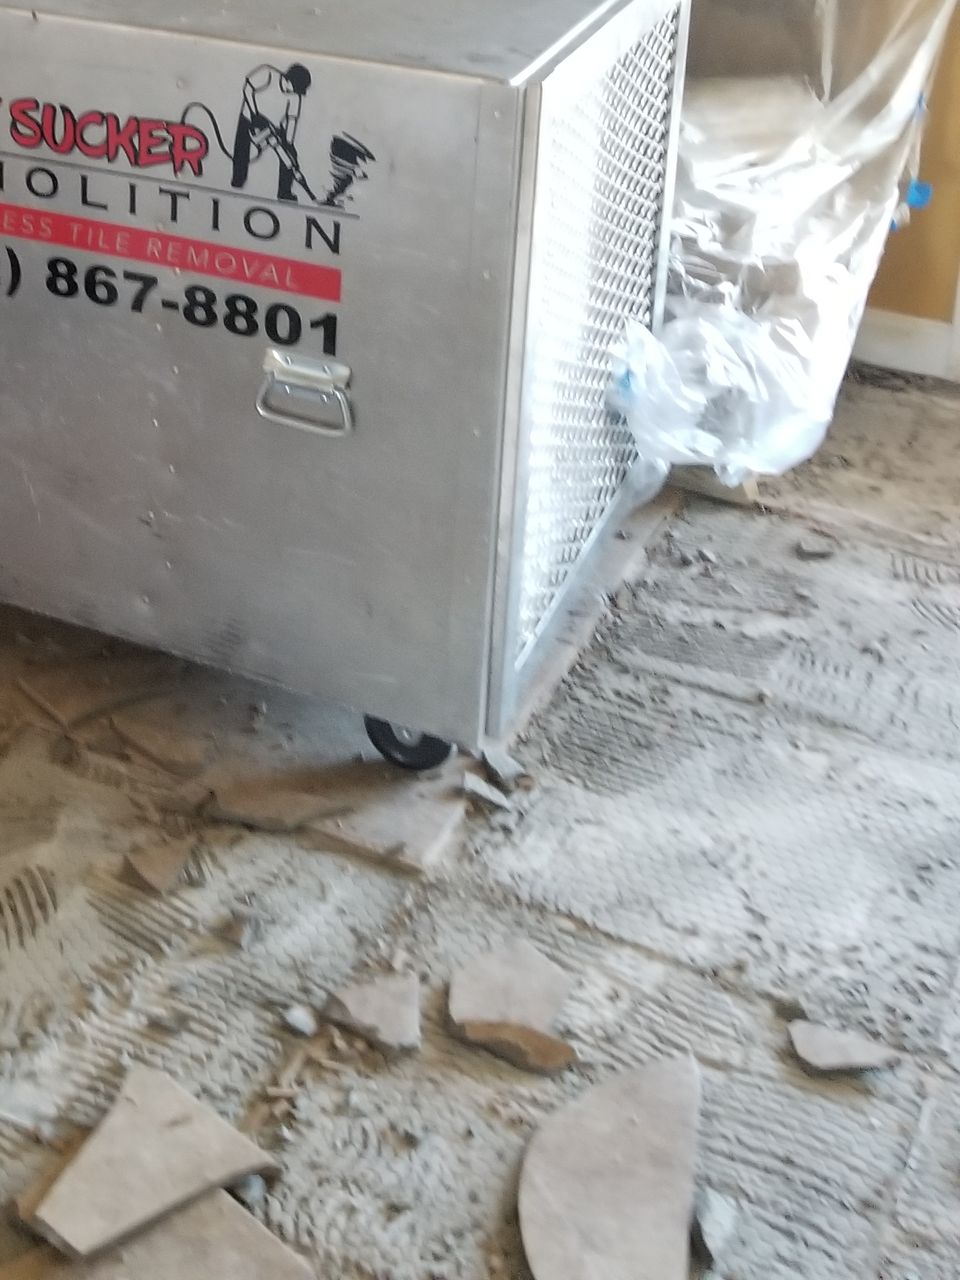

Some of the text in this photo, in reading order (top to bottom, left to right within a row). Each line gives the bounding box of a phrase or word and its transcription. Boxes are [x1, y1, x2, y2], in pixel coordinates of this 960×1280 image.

[10, 98, 209, 176] SUCKER
[70, 221, 130, 253] TILE
[146, 237, 299, 288] REMOVAL
[45, 257, 339, 356] 867-8801
